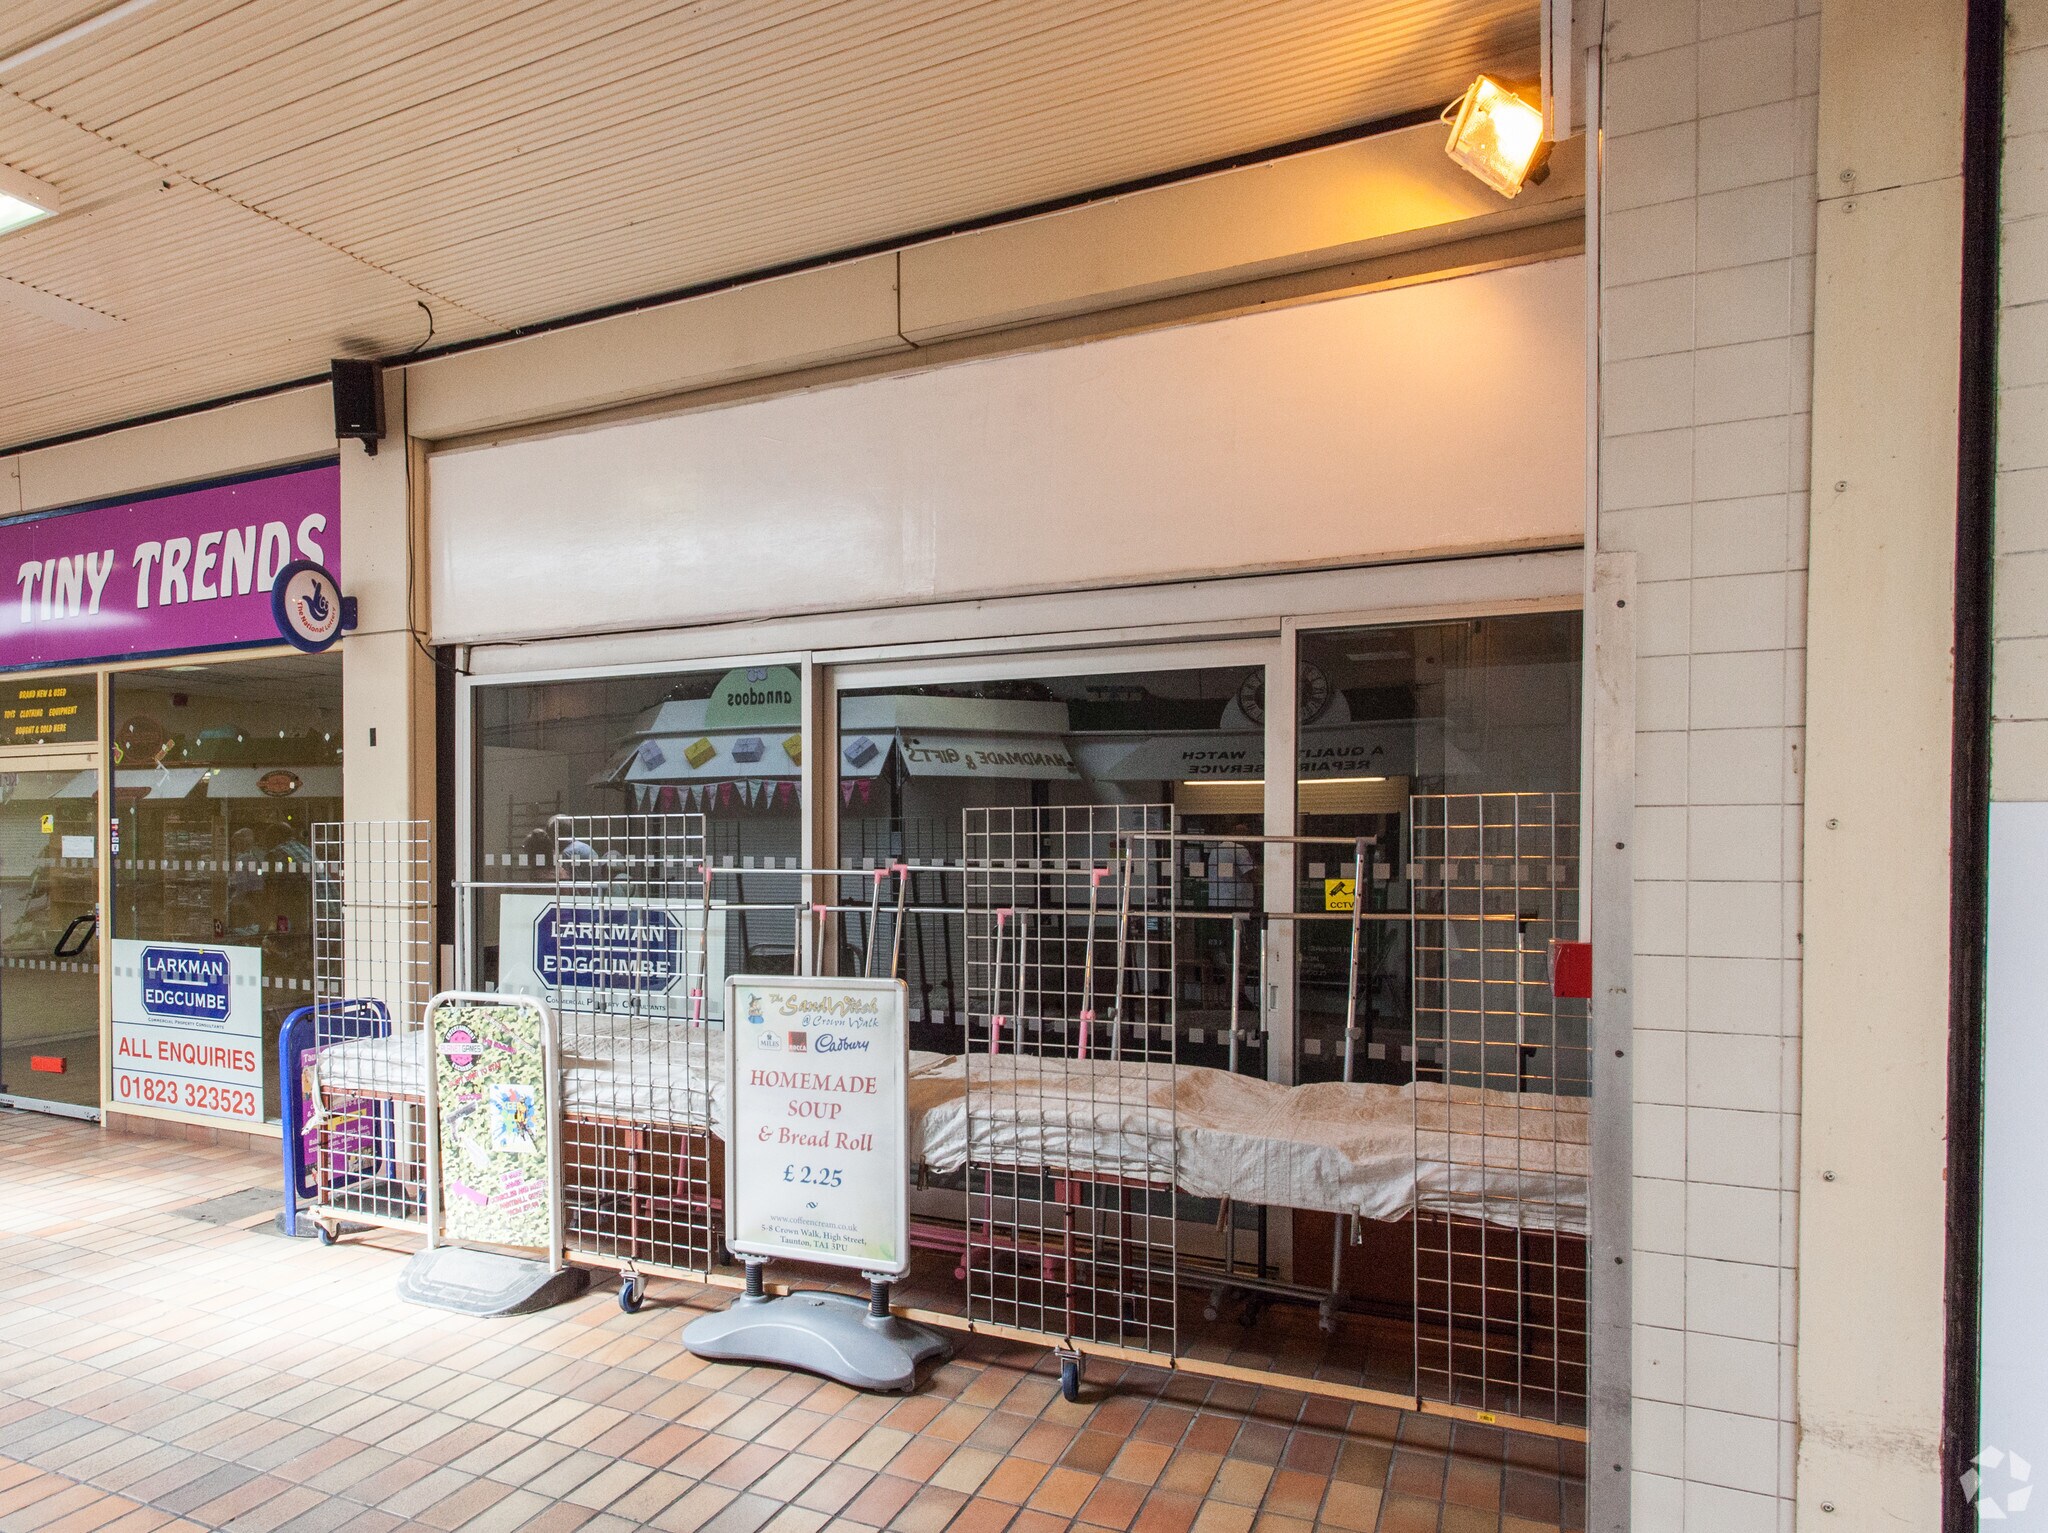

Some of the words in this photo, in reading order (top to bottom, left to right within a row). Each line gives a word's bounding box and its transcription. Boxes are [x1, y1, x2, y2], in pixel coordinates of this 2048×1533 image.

[16, 549, 115, 624] TINY
[132, 513, 327, 608] TRENDS
[301, 615, 325, 633] National
[325, 607, 336, 630] Lottery
[36, 689, 48, 698] NEW
[53, 688, 67, 697] USED
[48, 705, 78, 717] EQUIPMENT
[40, 724, 53, 733] SOLD
[53, 723, 67, 732] HERE
[1330, 901, 1355, 909] CCTV
[551, 921, 664, 942] LARKMAN
[147, 956, 223, 976] LARKMAN
[543, 955, 671, 978] EDGCUMBE
[145, 988, 226, 1010] EDGCUMBE
[148, 1017, 173, 1025] COMMERCIAL
[174, 1019, 195, 1027] PROPERTY
[196, 1021, 225, 1030] CONSULTANTS
[802, 1015, 811, 1027] @
[813, 1015, 845, 1027] Crown
[849, 1016, 879, 1029] Walk
[462, 1044, 482, 1053] GAMES
[760, 1040, 779, 1048] MILES
[815, 1033, 870, 1053] Cadbury
[119, 1036, 152, 1059] ALL
[158, 1040, 256, 1073] ENQUIRIES
[750, 1069, 878, 1095] HOMEMADE
[120, 1075, 178, 1105] 01823
[185, 1083, 256, 1117] 323523
[787, 1099, 842, 1120] SOUP
[758, 1125, 773, 1142] &
[778, 1127, 830, 1148] Bread
[835, 1132, 873, 1152] Roll
[783, 1164, 795, 1182] £
[800, 1165, 843, 1188] 2.25
[770, 1213, 858, 1233] www.coffeencream.co.uk
[761, 1224, 773, 1232] 5-8
[775, 1225, 799, 1235] Crown
[800, 1228, 822, 1239] Walk,
[823, 1231, 842, 1243] High
[843, 1234, 867, 1246] Street,
[780, 1235, 812, 1248] Taunton,
[831, 1242, 848, 1252] 3PU
